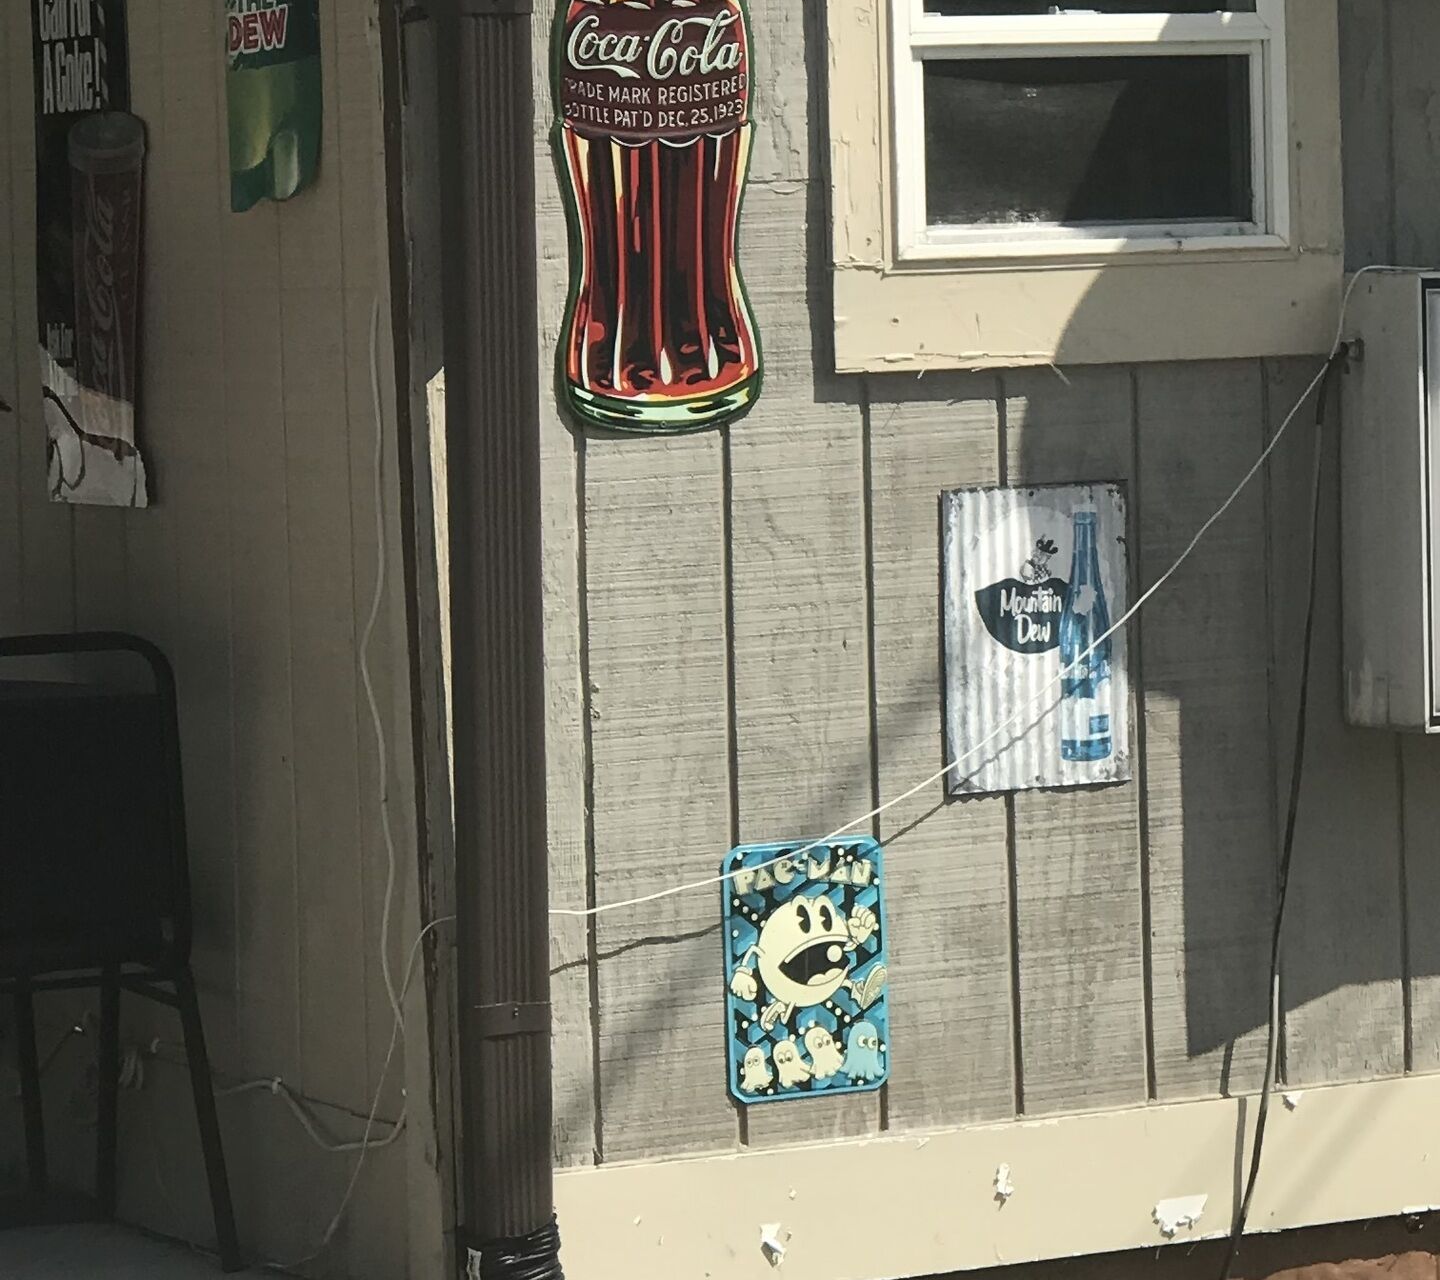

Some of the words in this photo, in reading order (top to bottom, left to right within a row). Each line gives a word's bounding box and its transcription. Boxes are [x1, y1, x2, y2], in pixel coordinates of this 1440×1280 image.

[229, 8, 287, 52] DEW
[567, 9, 744, 80] Coca-Cola
[43, 43, 54, 114] A
[565, 77, 604, 101] RADE
[608, 85, 651, 105] MARK
[657, 73, 746, 106] REGISTERED
[614, 109, 653, 128] PAT'D
[714, 98, 744, 120] 1923
[999, 586, 1063, 617] Mountain
[1014, 615, 1052, 645] Dew
[733, 856, 873, 896] PAC-MAN
